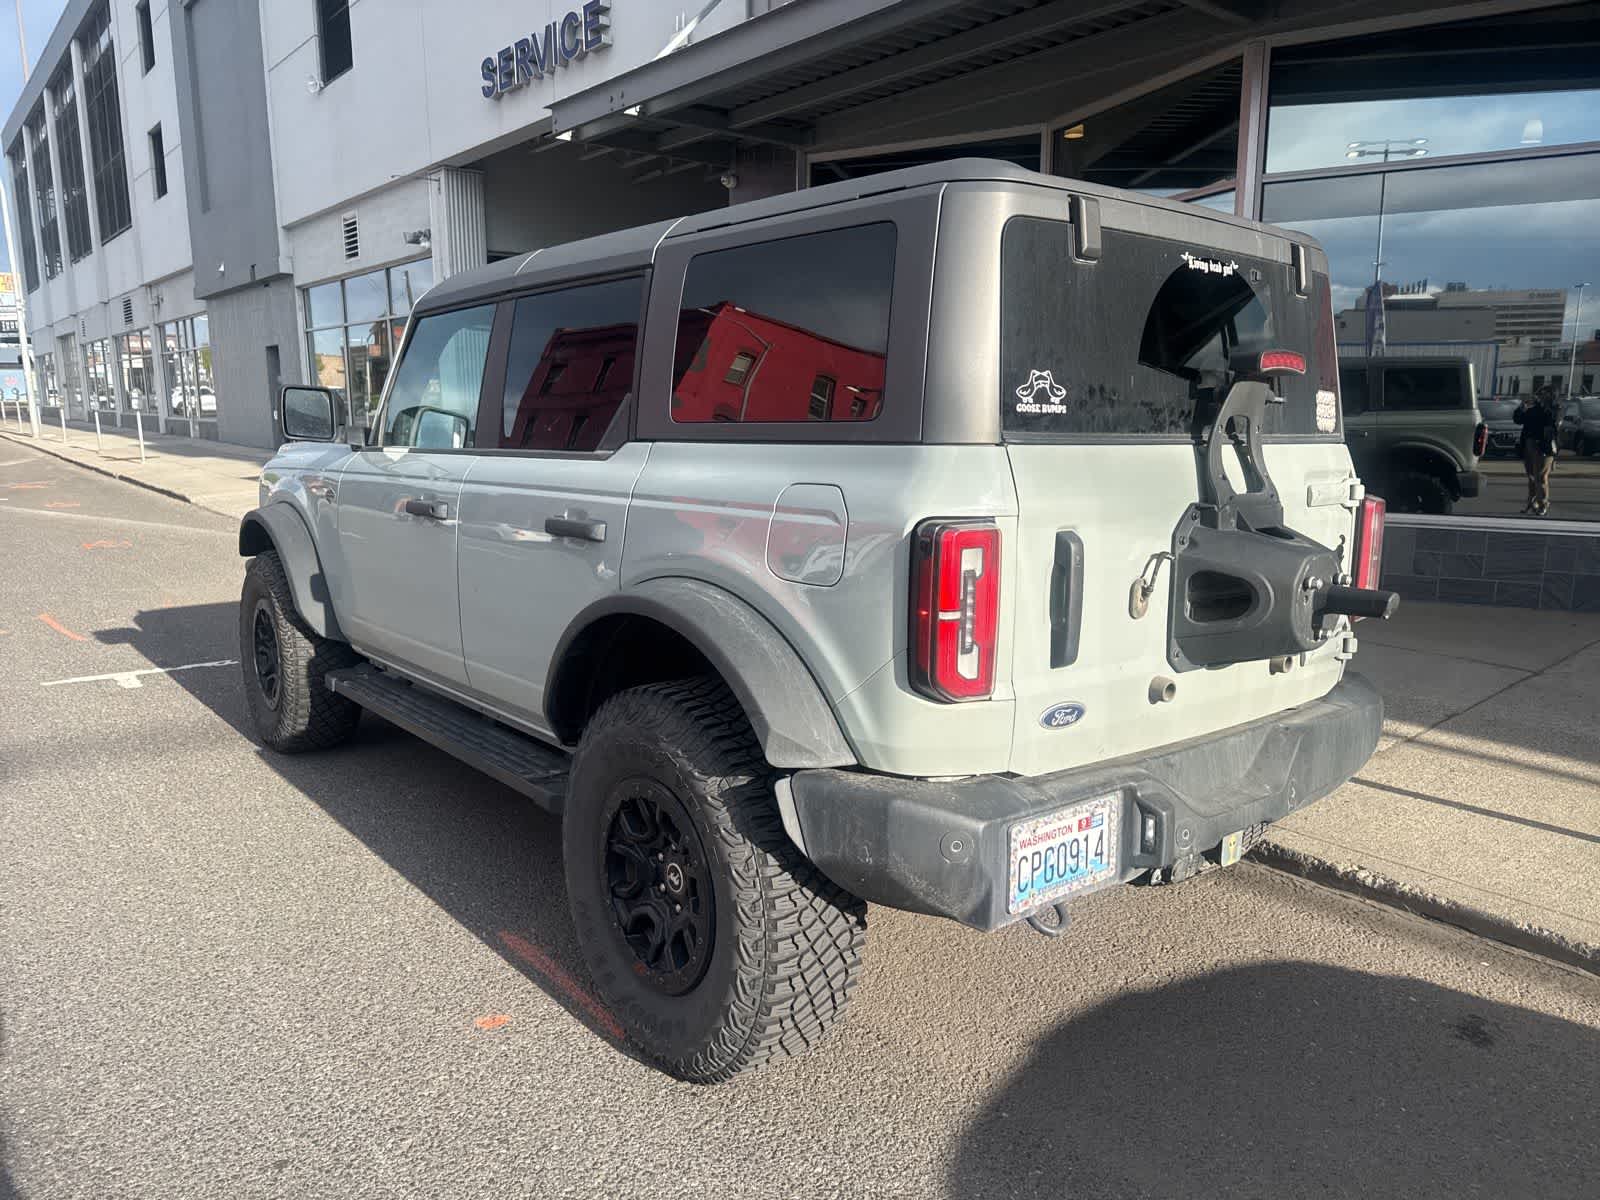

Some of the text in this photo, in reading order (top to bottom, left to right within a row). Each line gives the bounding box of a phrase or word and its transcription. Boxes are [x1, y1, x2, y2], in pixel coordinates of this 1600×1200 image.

[481, 0, 607, 99] SERVICE
[1016, 403, 1041, 413] GOOSE
[1052, 708, 1078, 726] Ford
[1020, 824, 1073, 849] WASHINGTON
[1017, 829, 1104, 893] CPG0914
